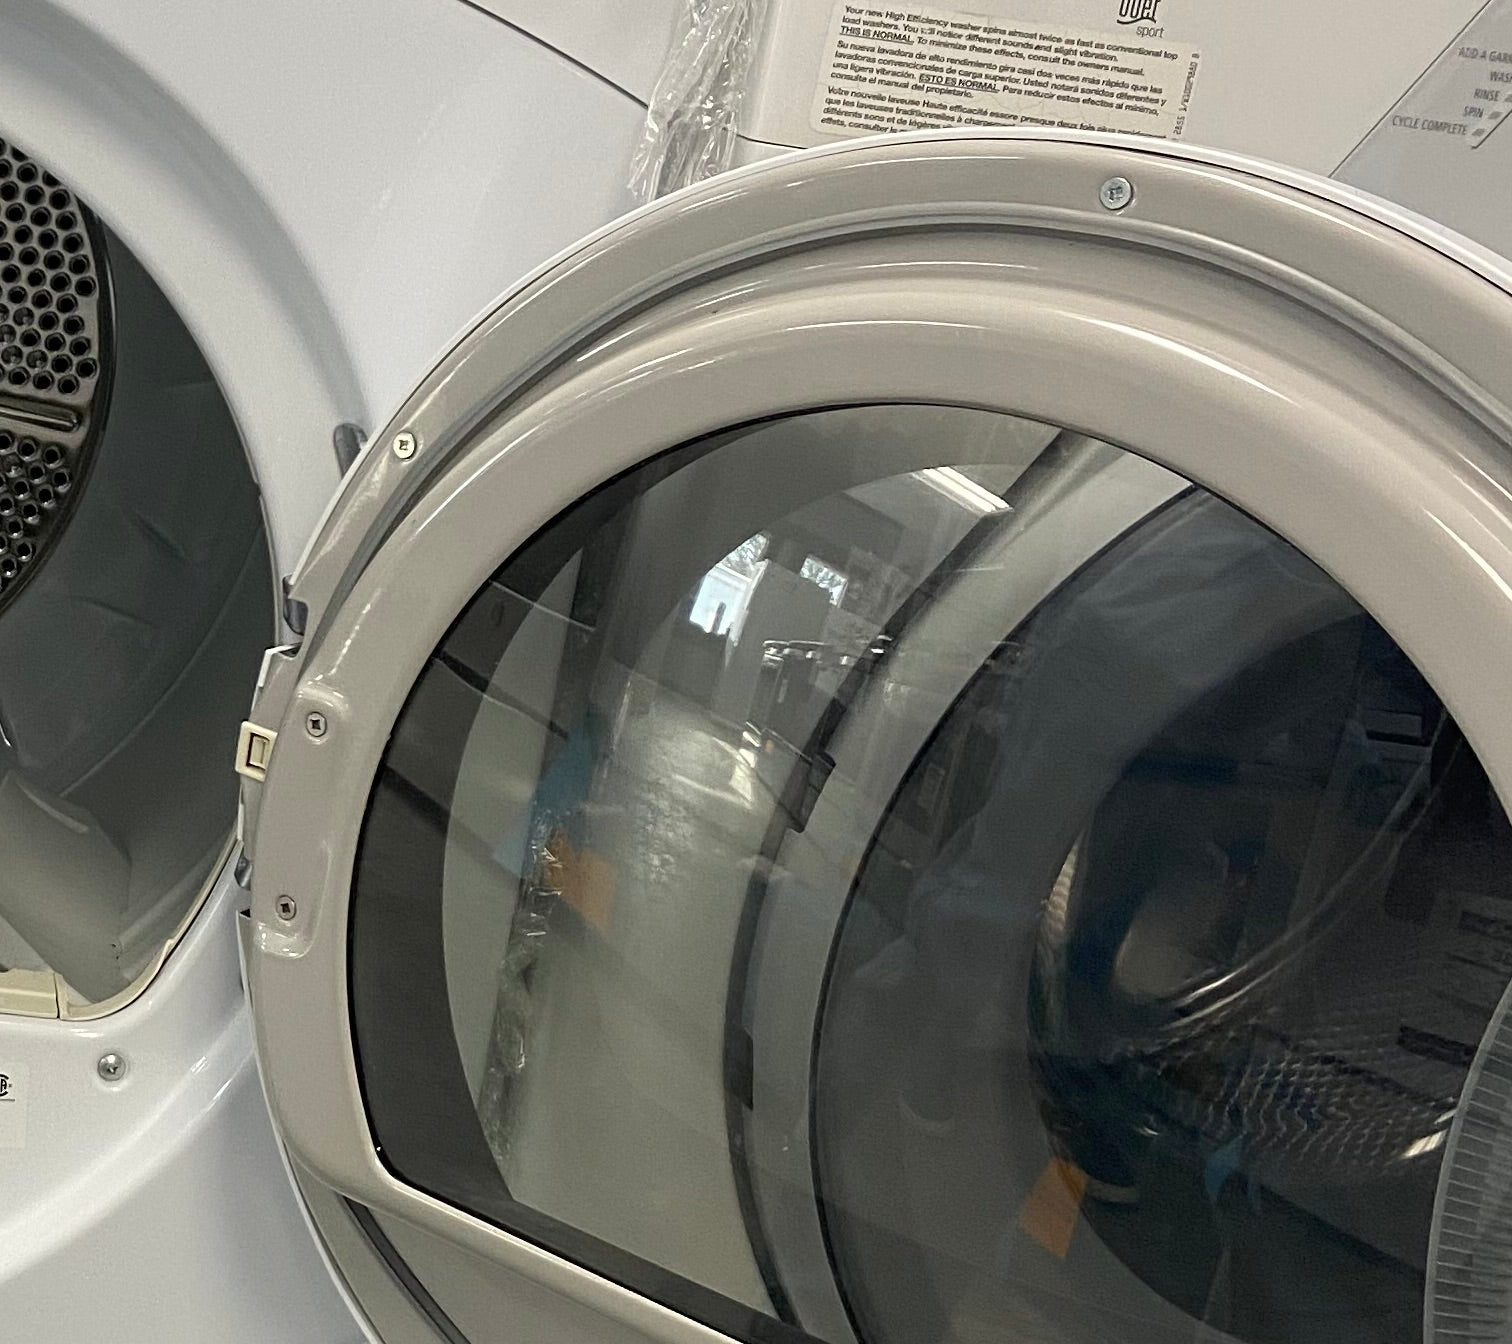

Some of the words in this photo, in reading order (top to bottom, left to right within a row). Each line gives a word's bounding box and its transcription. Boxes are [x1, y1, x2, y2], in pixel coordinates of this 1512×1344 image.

[1135, 24, 1165, 39] sport
[1473, 88, 1501, 102] RINSE
[1463, 105, 1484, 118] SPIN
[1392, 115, 1419, 130] CYCLE
[1421, 118, 1468, 136] COMPLETE
